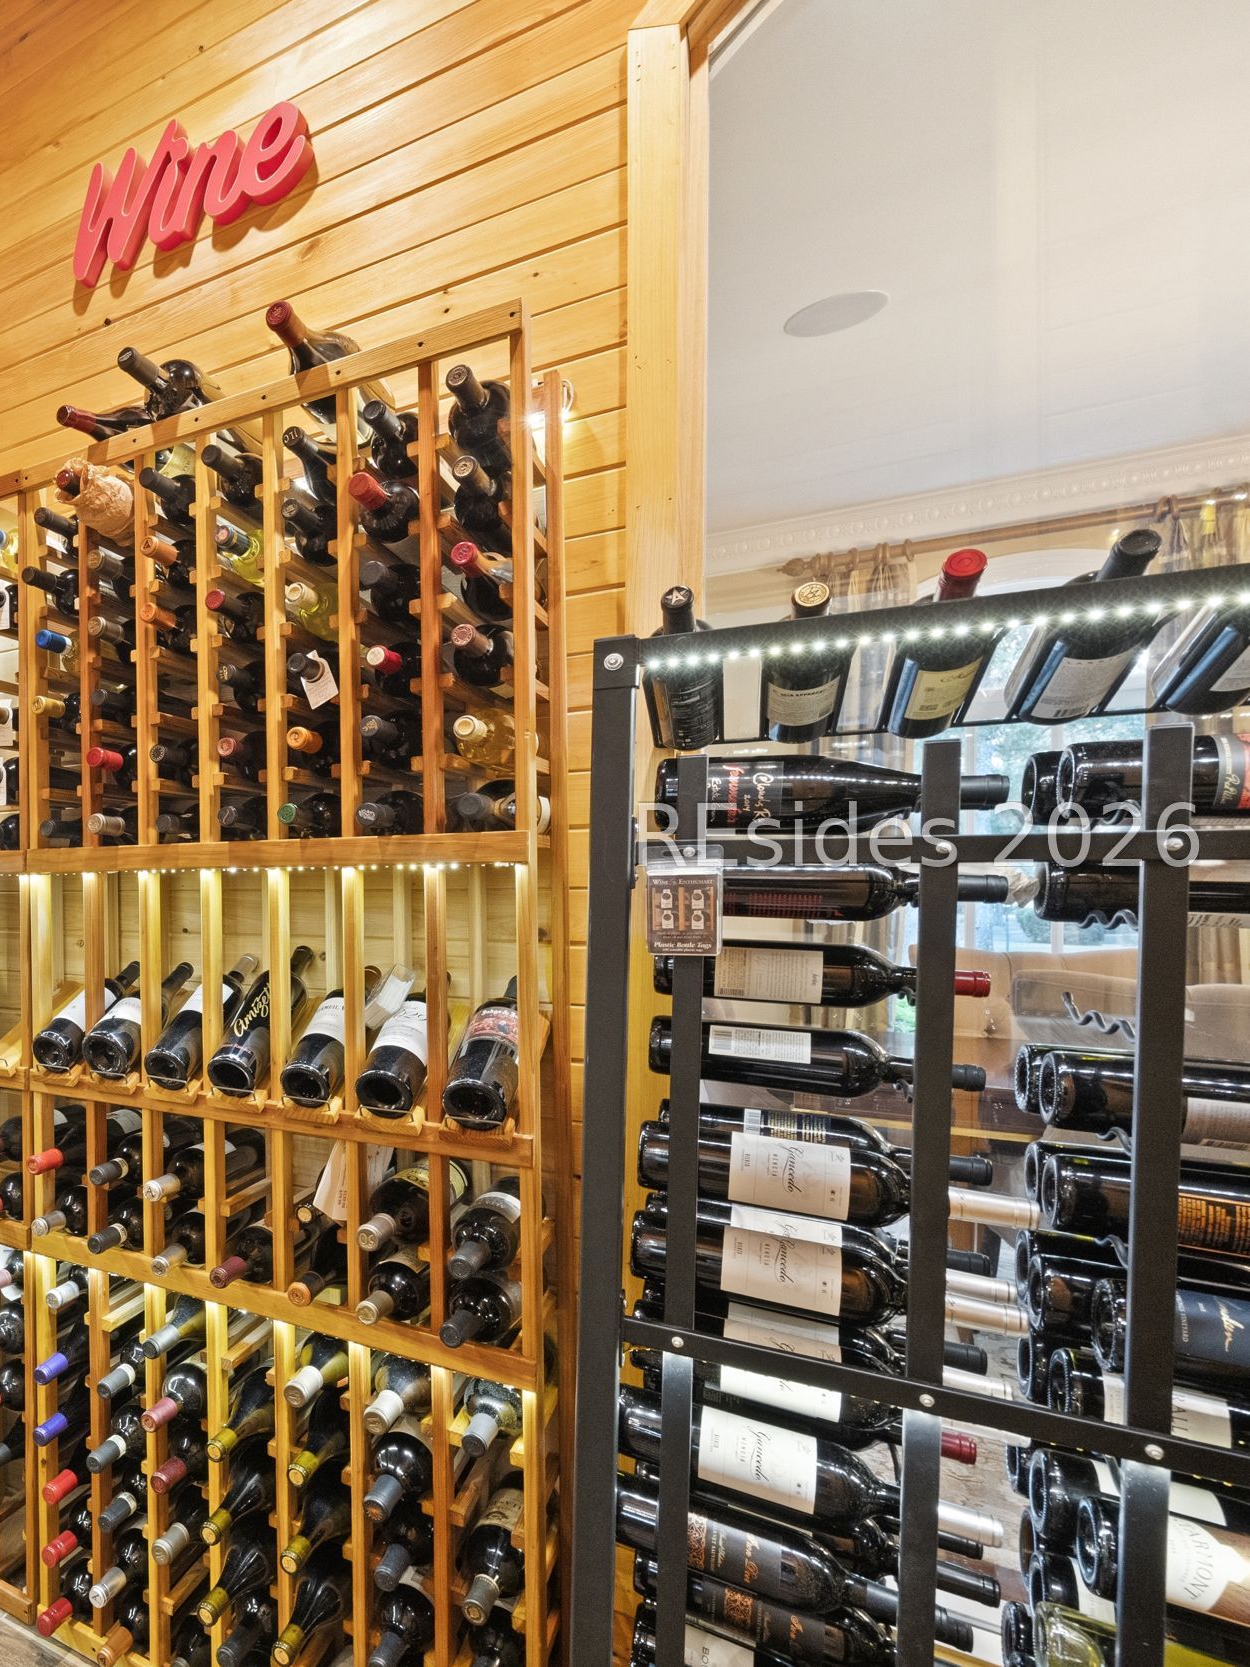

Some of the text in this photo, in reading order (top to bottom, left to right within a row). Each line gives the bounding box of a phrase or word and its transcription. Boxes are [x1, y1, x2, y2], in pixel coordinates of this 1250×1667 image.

[73, 100, 314, 288] Wine
[697, 942, 712, 950] Tags
[781, 1144, 804, 1194] Gancedo
